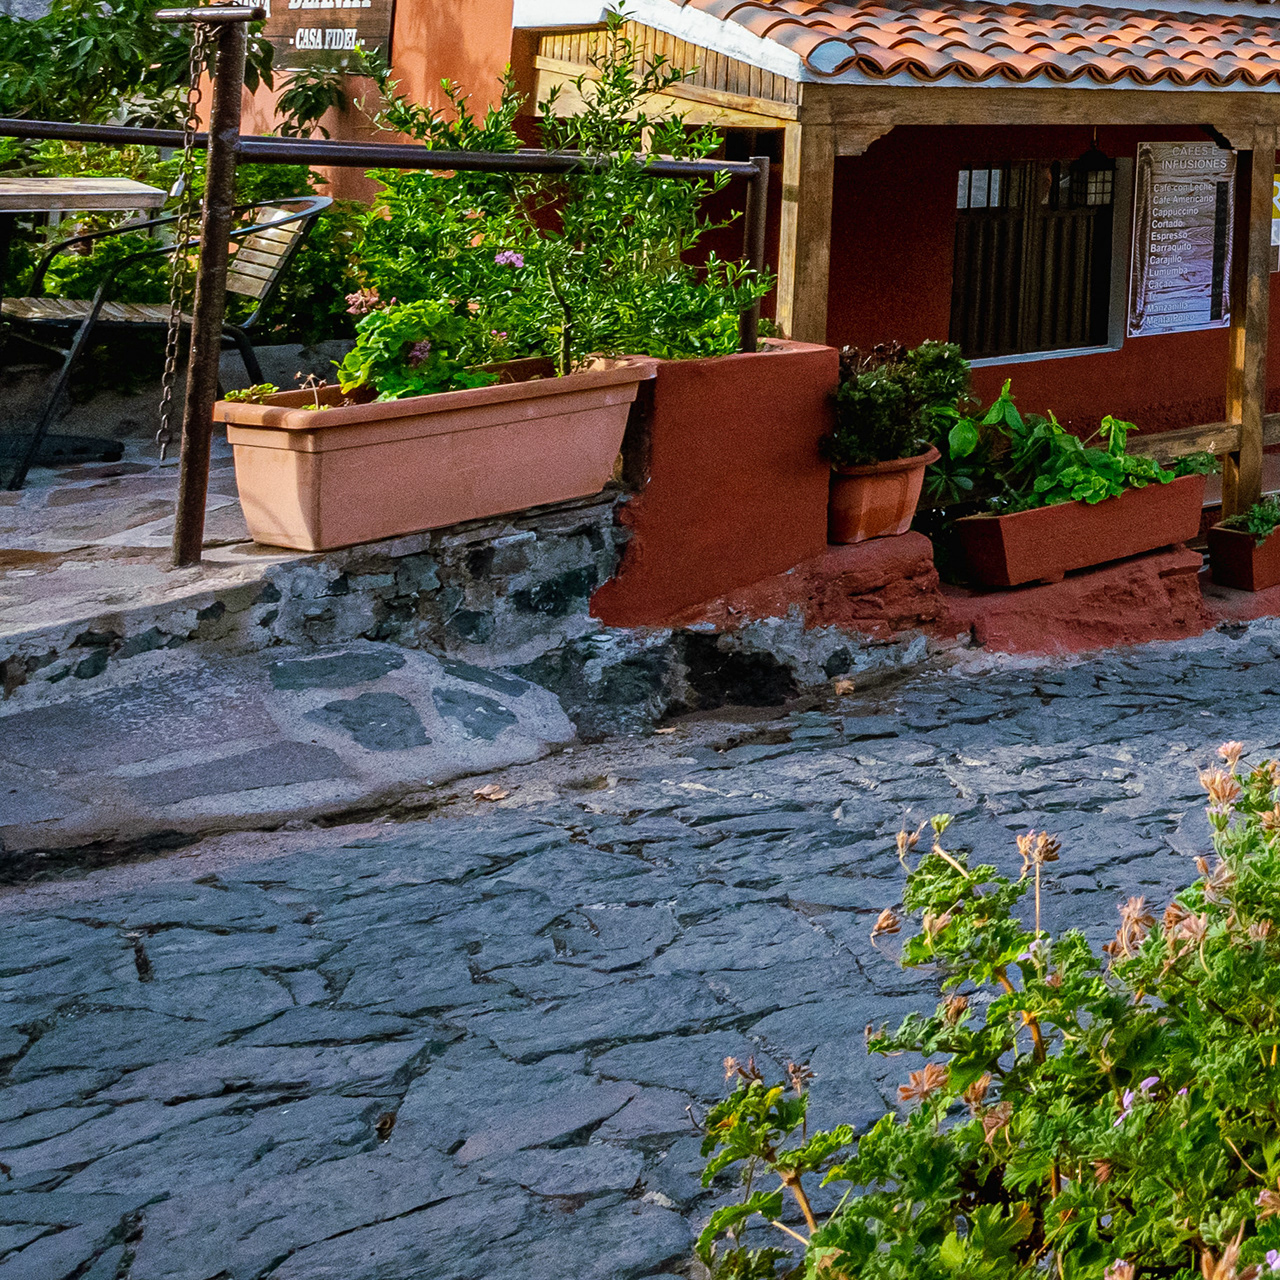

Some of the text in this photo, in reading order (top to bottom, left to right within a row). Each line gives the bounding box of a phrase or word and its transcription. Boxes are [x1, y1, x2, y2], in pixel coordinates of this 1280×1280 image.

[295, 28, 323, 50] CASA
[323, 28, 359, 50] FIDEL
[1161, 158, 1228, 170] INFUSIONES
[1190, 183, 1213, 192] Leche
[1172, 195, 1214, 203] Americano
[1152, 207, 1199, 218] Cappuccino
[1151, 220, 1183, 229] Cortado
[1151, 231, 1188, 242] Espresso
[1150, 243, 1192, 253] Barraquito
[1149, 255, 1182, 266] Carajillo
[1148, 267, 1188, 277] Lumumba
[1147, 301, 1189, 313] Manzanilla
